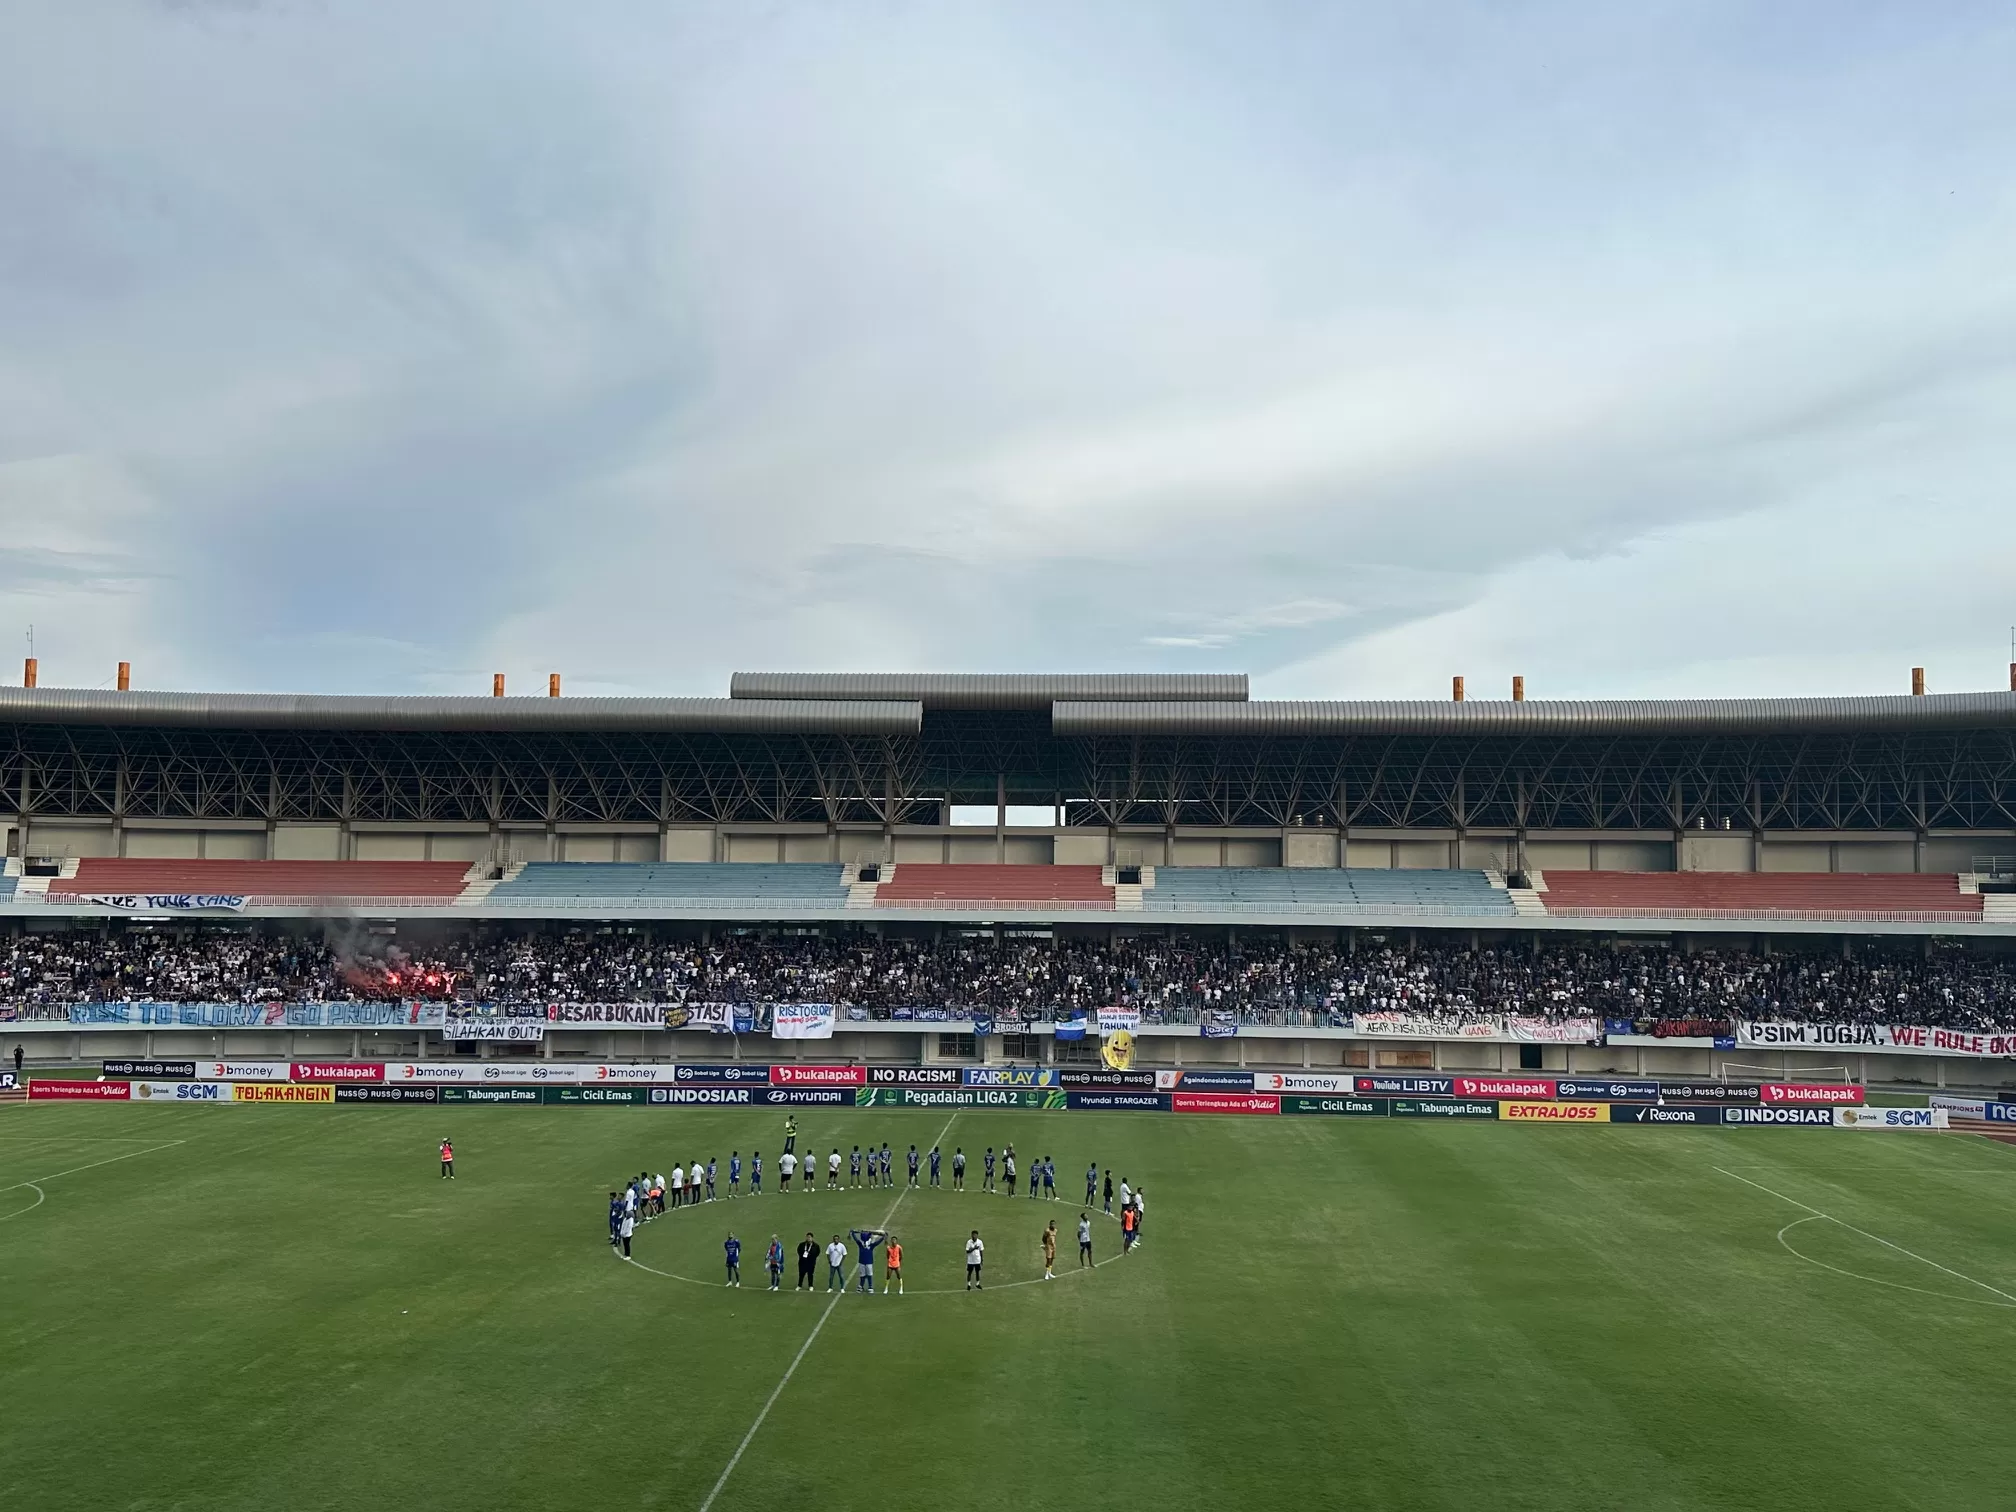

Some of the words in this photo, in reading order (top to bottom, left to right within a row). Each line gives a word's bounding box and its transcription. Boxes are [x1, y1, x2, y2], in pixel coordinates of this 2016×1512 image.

[70, 1002, 129, 1024] RISE
[138, 1003, 172, 1024] TO
[286, 1003, 322, 1025] GO
[557, 1005, 602, 1021] BESAR
[605, 1005, 653, 1023] BUKAN
[779, 1005, 798, 1017] RISE
[799, 1005, 811, 1017] TO
[444, 1025, 504, 1039] SILAHKAN
[1464, 1025, 1492, 1036] UANG
[1750, 1026, 1804, 1042] PSIM
[1814, 1026, 1884, 1046] JOGJA,
[1890, 1025, 1926, 1046] WE
[1934, 1030, 1984, 1053] RULE
[226, 1065, 273, 1078] bmoney
[314, 1066, 376, 1079] bukalapak
[416, 1066, 464, 1079] bmoney
[609, 1068, 657, 1080] bmoney
[795, 1068, 858, 1081] bukalapak
[874, 1069, 895, 1082] NO
[898, 1069, 956, 1082] RACISM!
[970, 1070, 1034, 1085] FAIRPLAY
[1184, 1076, 1252, 1085] ligaindonesiabaru.com
[1285, 1076, 1338, 1090] bmoney
[1373, 1080, 1400, 1090] YouTube
[1403, 1080, 1448, 1092] LIBTV
[101, 1085, 127, 1095] Vidio
[177, 1084, 217, 1099] SCM
[583, 1090, 603, 1100] Cicil
[606, 1091, 632, 1100] Emas
[1480, 1082, 1547, 1095] bukalapak
[1788, 1088, 1855, 1101] bukalapak
[467, 1090, 510, 1101] Tabungan
[511, 1090, 536, 1099] Emas
[669, 1089, 749, 1102] INDOSIAR
[790, 1092, 841, 1101] HYUNDAI
[905, 1090, 973, 1105] Pegadaian
[977, 1091, 1007, 1104] LIGA
[1009, 1092, 1018, 1104] 2
[1080, 1096, 1111, 1104] Hyundai
[1114, 1097, 1158, 1105] STARGAZER
[1176, 1099, 1195, 1107] Sports
[1248, 1099, 1276, 1109] Vidio
[1321, 1100, 1343, 1111] Cicil
[1346, 1101, 1373, 1111] Emas
[1420, 1103, 1465, 1115] Tabungan
[1466, 1104, 1492, 1113] Emas
[1650, 1108, 1695, 1121] Rexona
[1744, 1109, 1830, 1123] INDOSIAR
[1886, 1110, 1931, 1126] SCM
